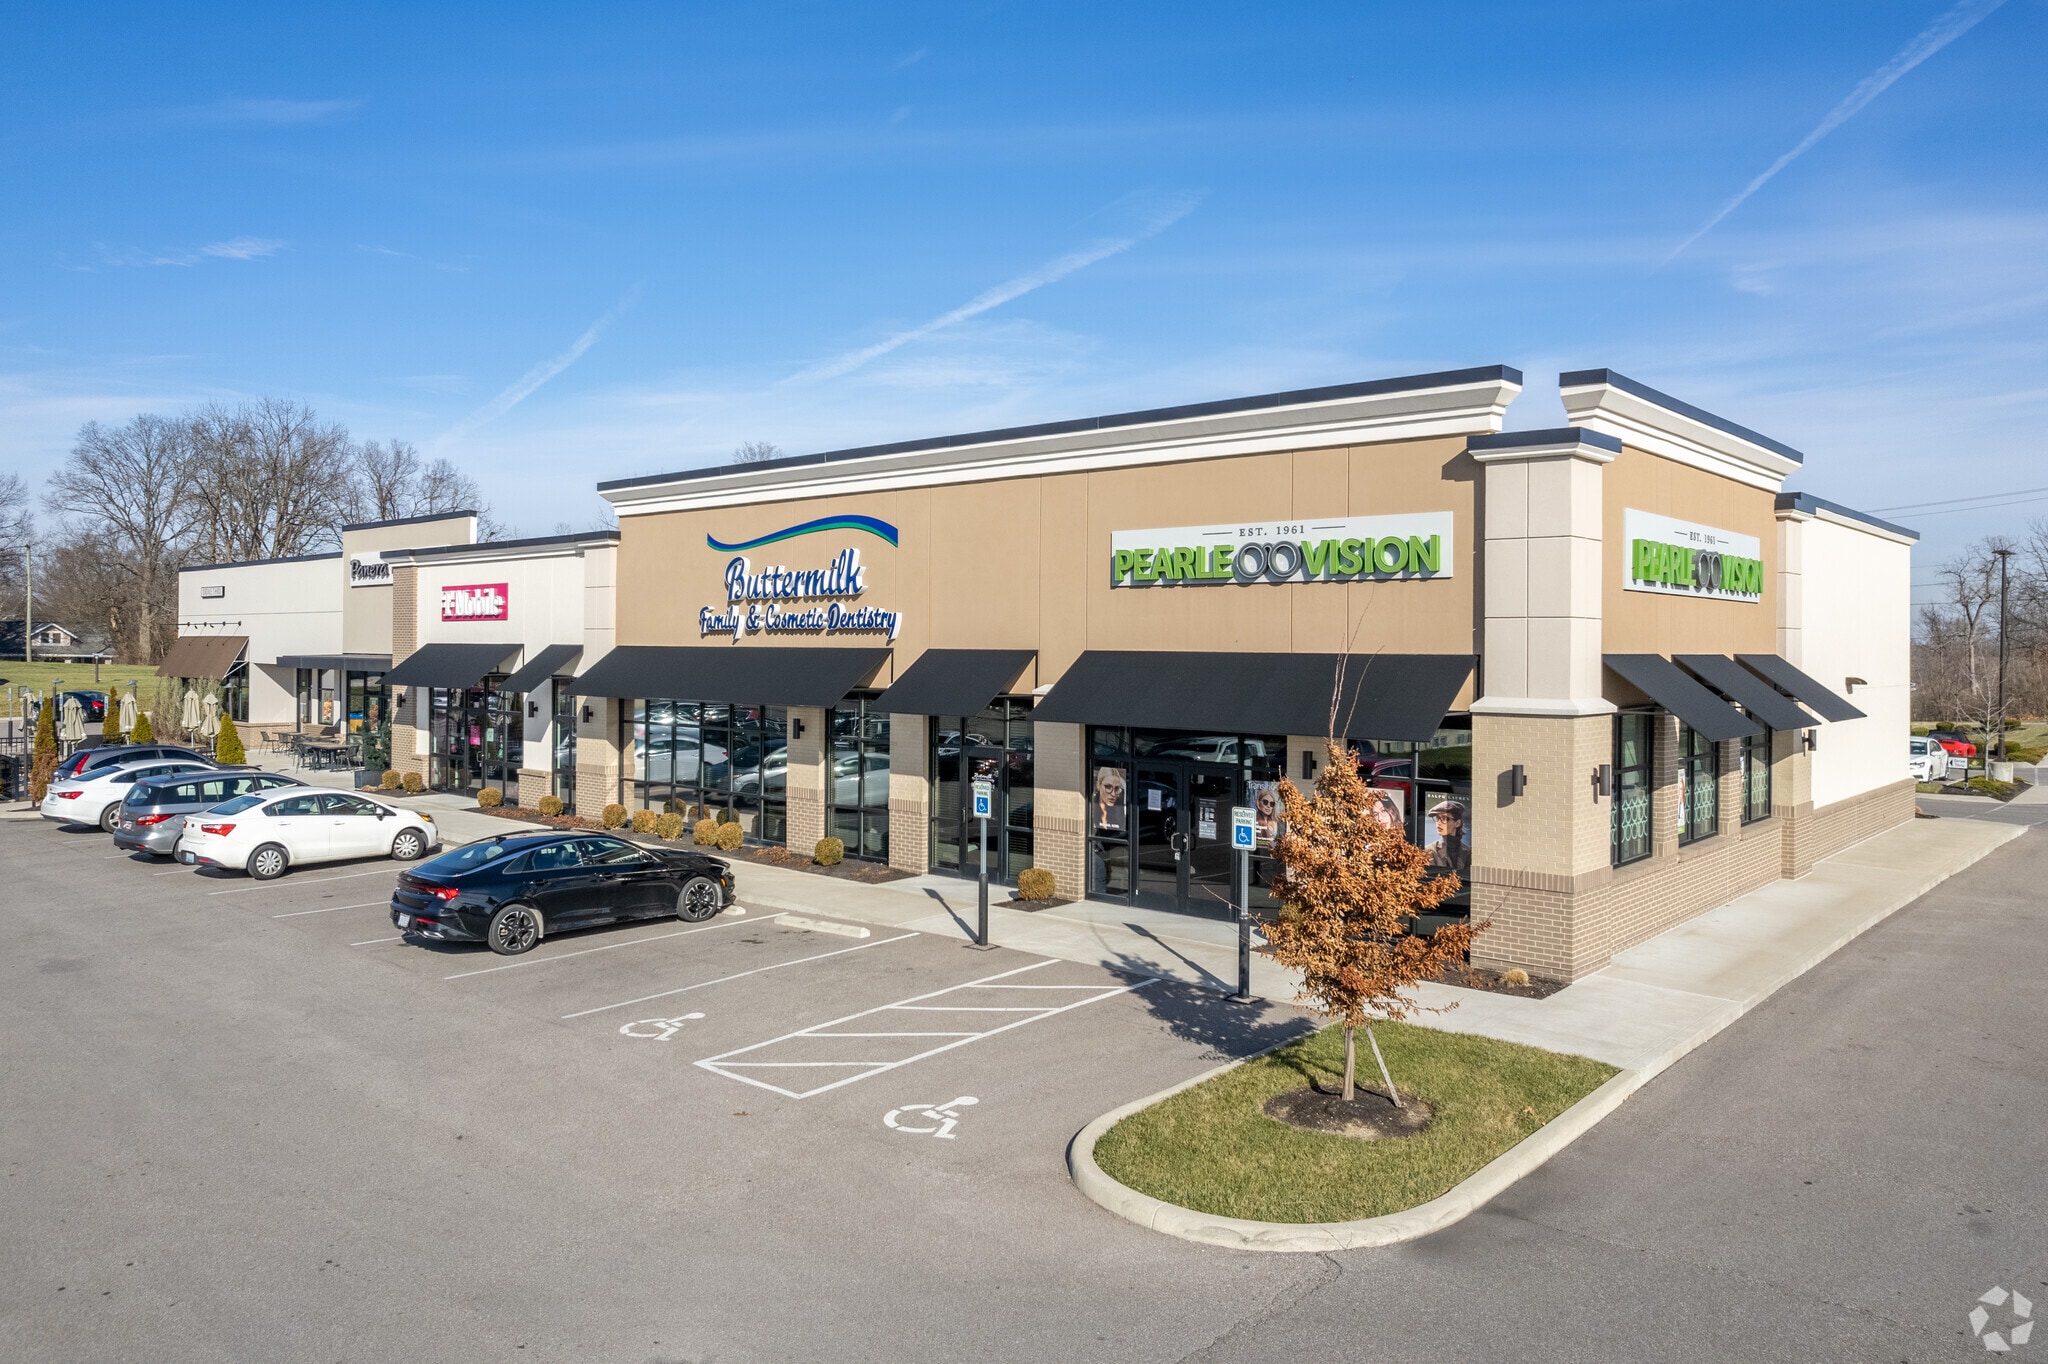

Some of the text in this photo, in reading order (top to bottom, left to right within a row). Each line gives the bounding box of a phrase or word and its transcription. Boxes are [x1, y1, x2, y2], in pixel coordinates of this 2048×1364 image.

[1239, 525, 1305, 537] EST. 1961
[1689, 531, 1716, 545] EST. 1961
[350, 559, 390, 580] Panera
[725, 548, 868, 601] Buttermilk
[1114, 534, 1441, 581] PEARLE VISION
[1632, 538, 1763, 594] PEARLE VISION
[699, 602, 902, 640] Family & Cosmetic Dentistry
